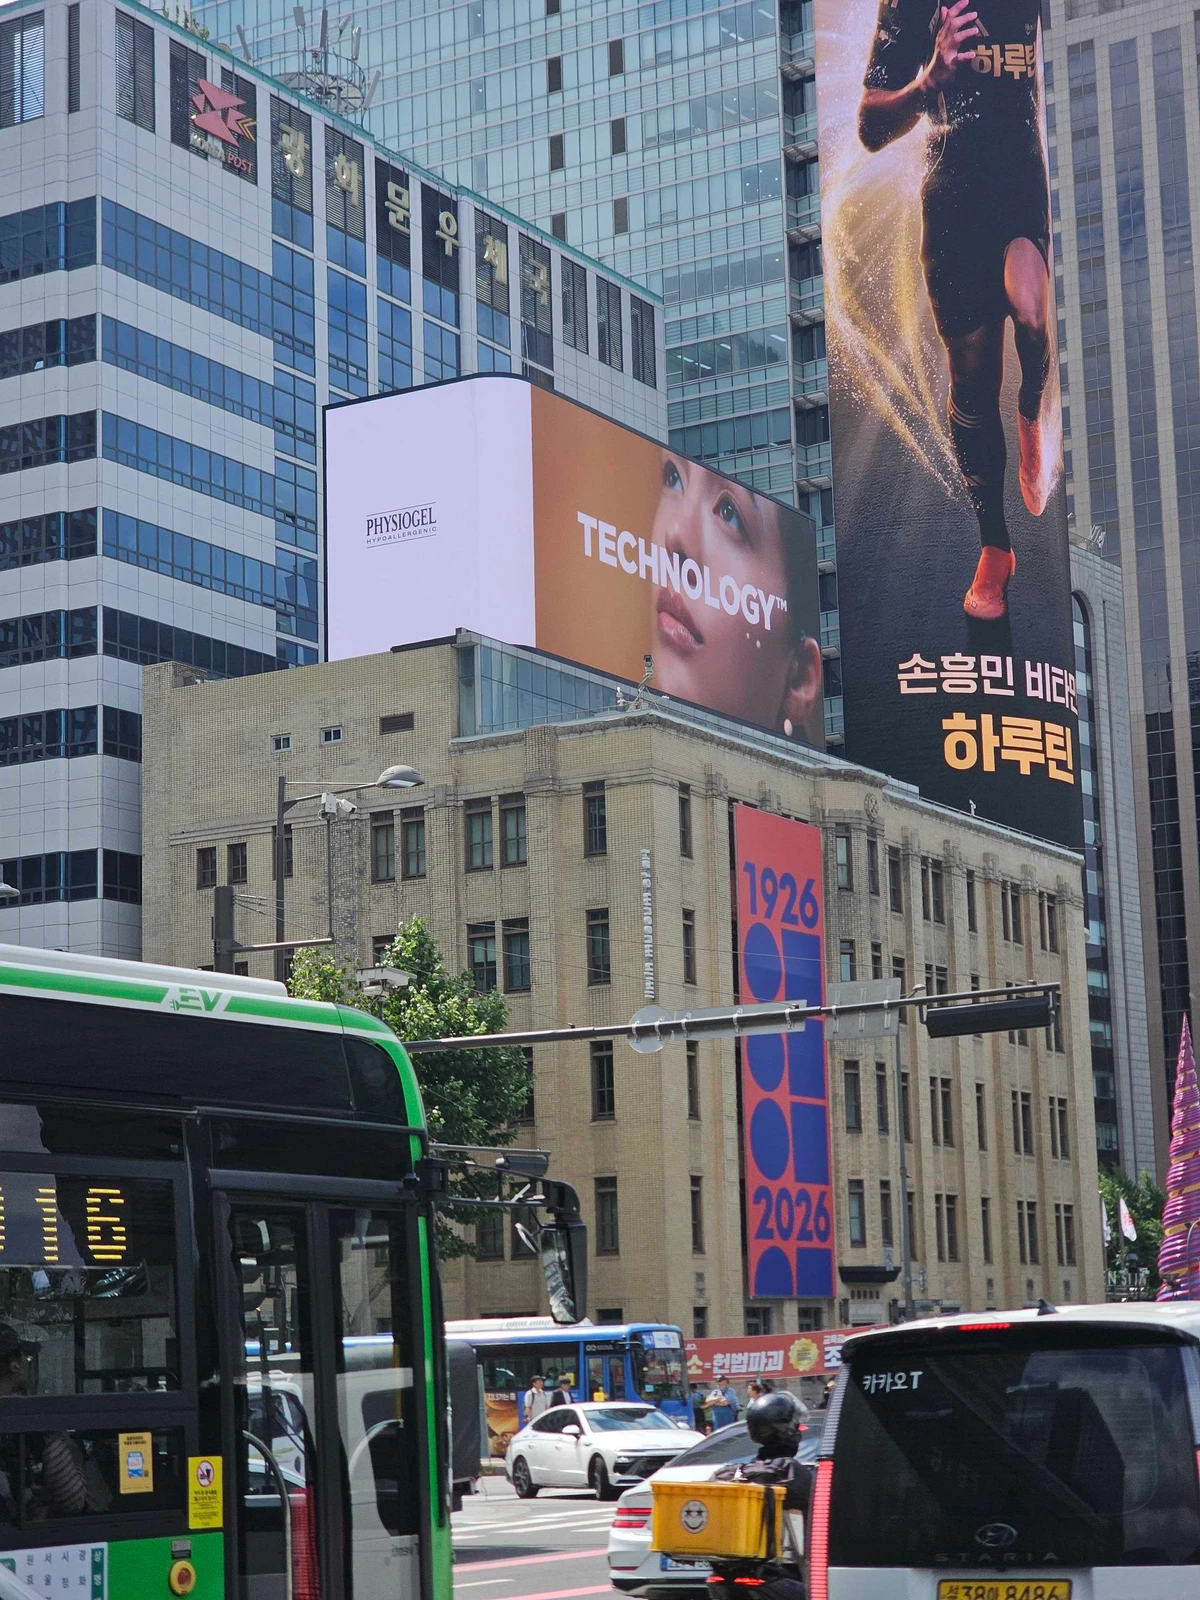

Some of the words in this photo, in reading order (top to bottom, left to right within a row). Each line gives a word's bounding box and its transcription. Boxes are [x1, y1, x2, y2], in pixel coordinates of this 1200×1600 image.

[226, 153, 253, 174] POST
[278, 122, 550, 306] 광화문우체국
[366, 507, 437, 536] PHYSIOGEL
[366, 526, 437, 544] HYPOALLERGENIC
[897, 652, 1015, 696] 손흥민
[1025, 660, 1079, 716] 비타민
[942, 712, 1075, 785] 하루틴
[743, 861, 819, 929] 1926
[172, 986, 222, 1011] EV
[0, 1187, 127, 1260] 16
[753, 1185, 831, 1244] 2026
